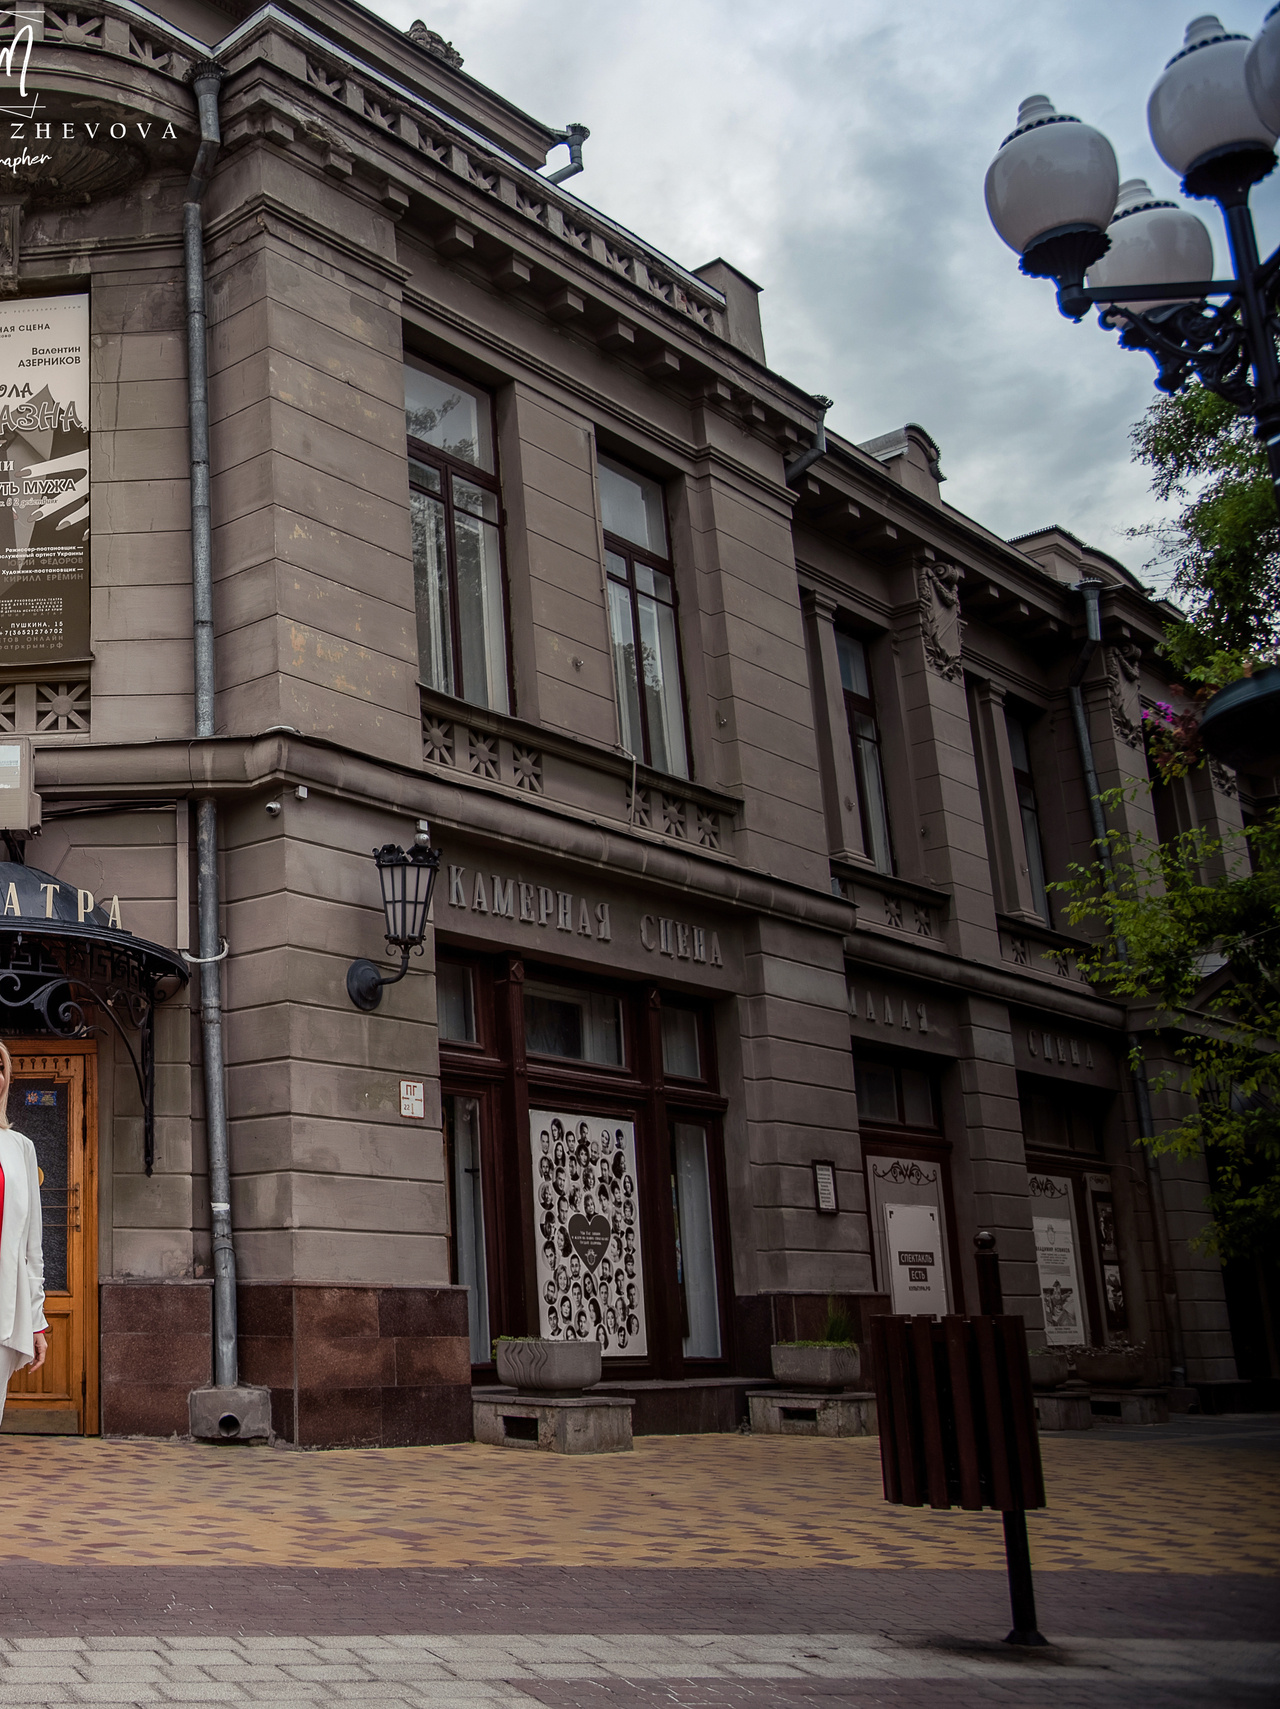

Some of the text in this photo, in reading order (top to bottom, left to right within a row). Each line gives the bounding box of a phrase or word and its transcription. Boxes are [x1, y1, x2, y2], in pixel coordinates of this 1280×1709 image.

[18, 323, 51, 332] СЦЕНА
[31, 346, 81, 356] Валентин
[17, 356, 81, 368] АЗЕРНИКОВ
[24, 478, 77, 494] МУЖА
[3, 575, 41, 583] КИРИЛЛ
[447, 863, 724, 968] КАМЕРНАЯ СЦЕНА
[1027, 1029, 1095, 1069] СЦЕНА
[405, 1084, 418, 1096] ПГ
[900, 1253, 933, 1263] СПЕКТАКЛЬ
[911, 1270, 926, 1280] ЕСТЬ
